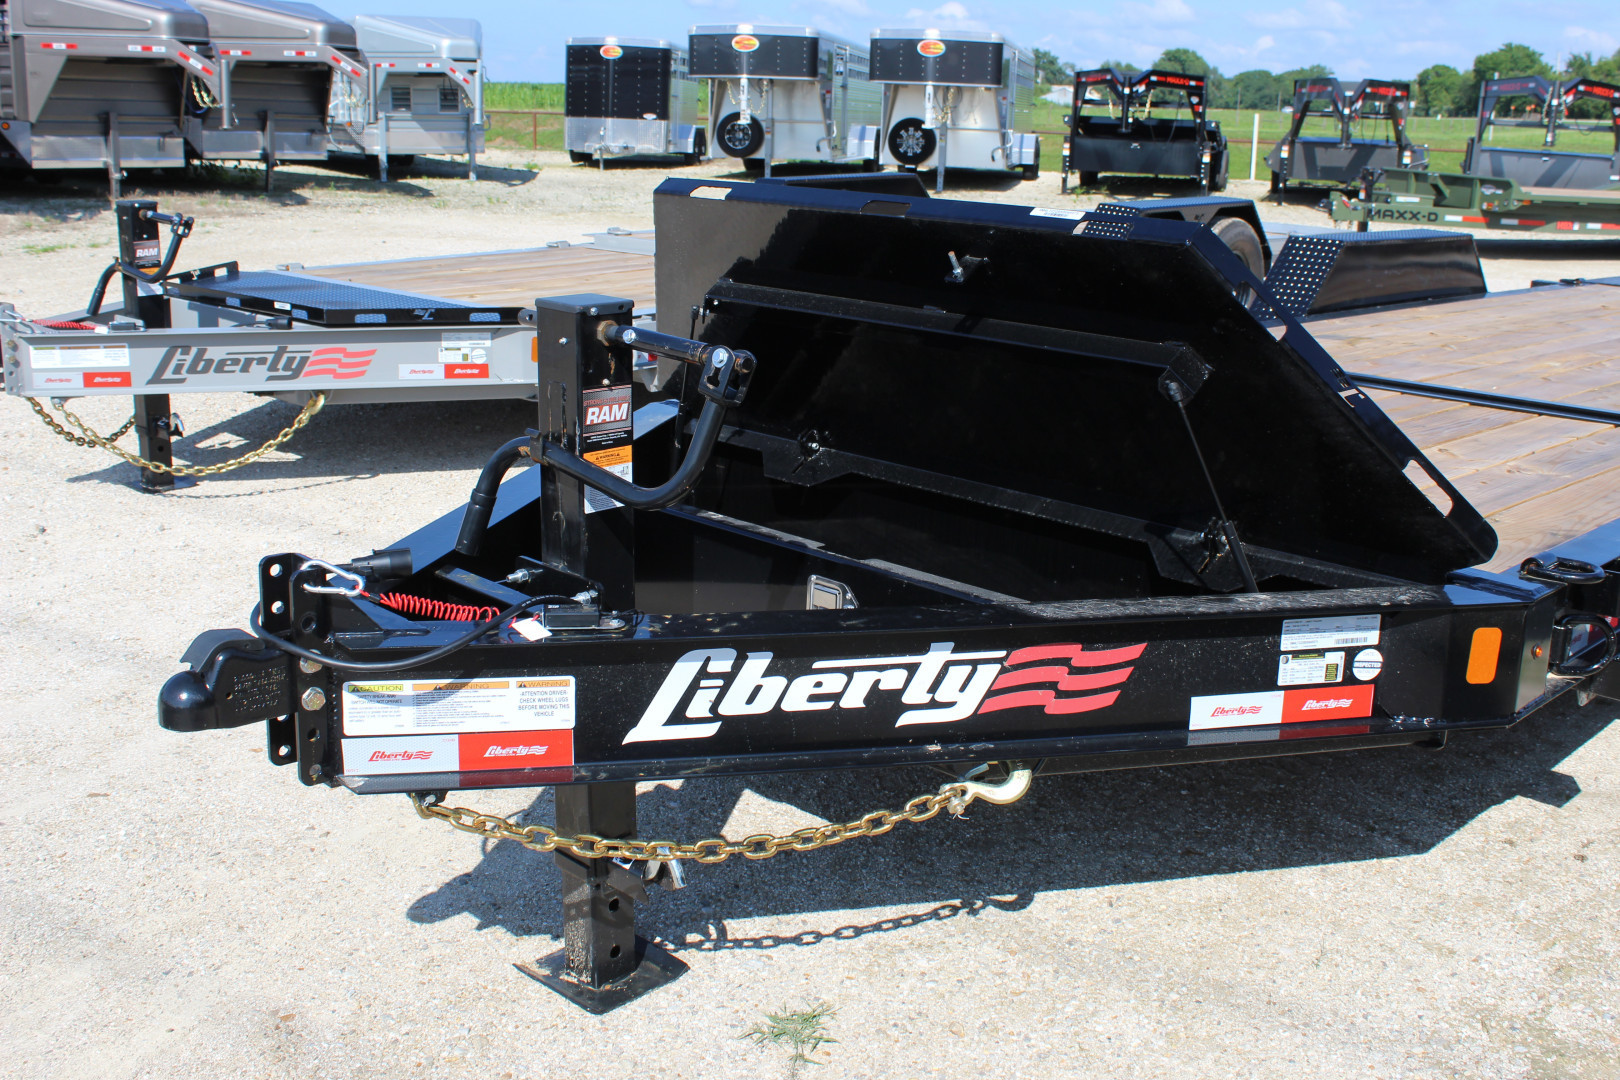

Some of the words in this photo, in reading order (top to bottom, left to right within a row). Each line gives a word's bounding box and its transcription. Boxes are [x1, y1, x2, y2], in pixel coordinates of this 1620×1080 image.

[1366, 208, 1439, 222] MAXX-D
[136, 247, 158, 257] RAM
[145, 345, 312, 385] Liberty
[586, 403, 629, 424] RAM
[622, 642, 1007, 745] Liberty
[1301, 698, 1338, 710] Liberty
[1210, 706, 1248, 717] Liberty
[368, 750, 414, 762] Liberty
[483, 745, 529, 757] Liberty
